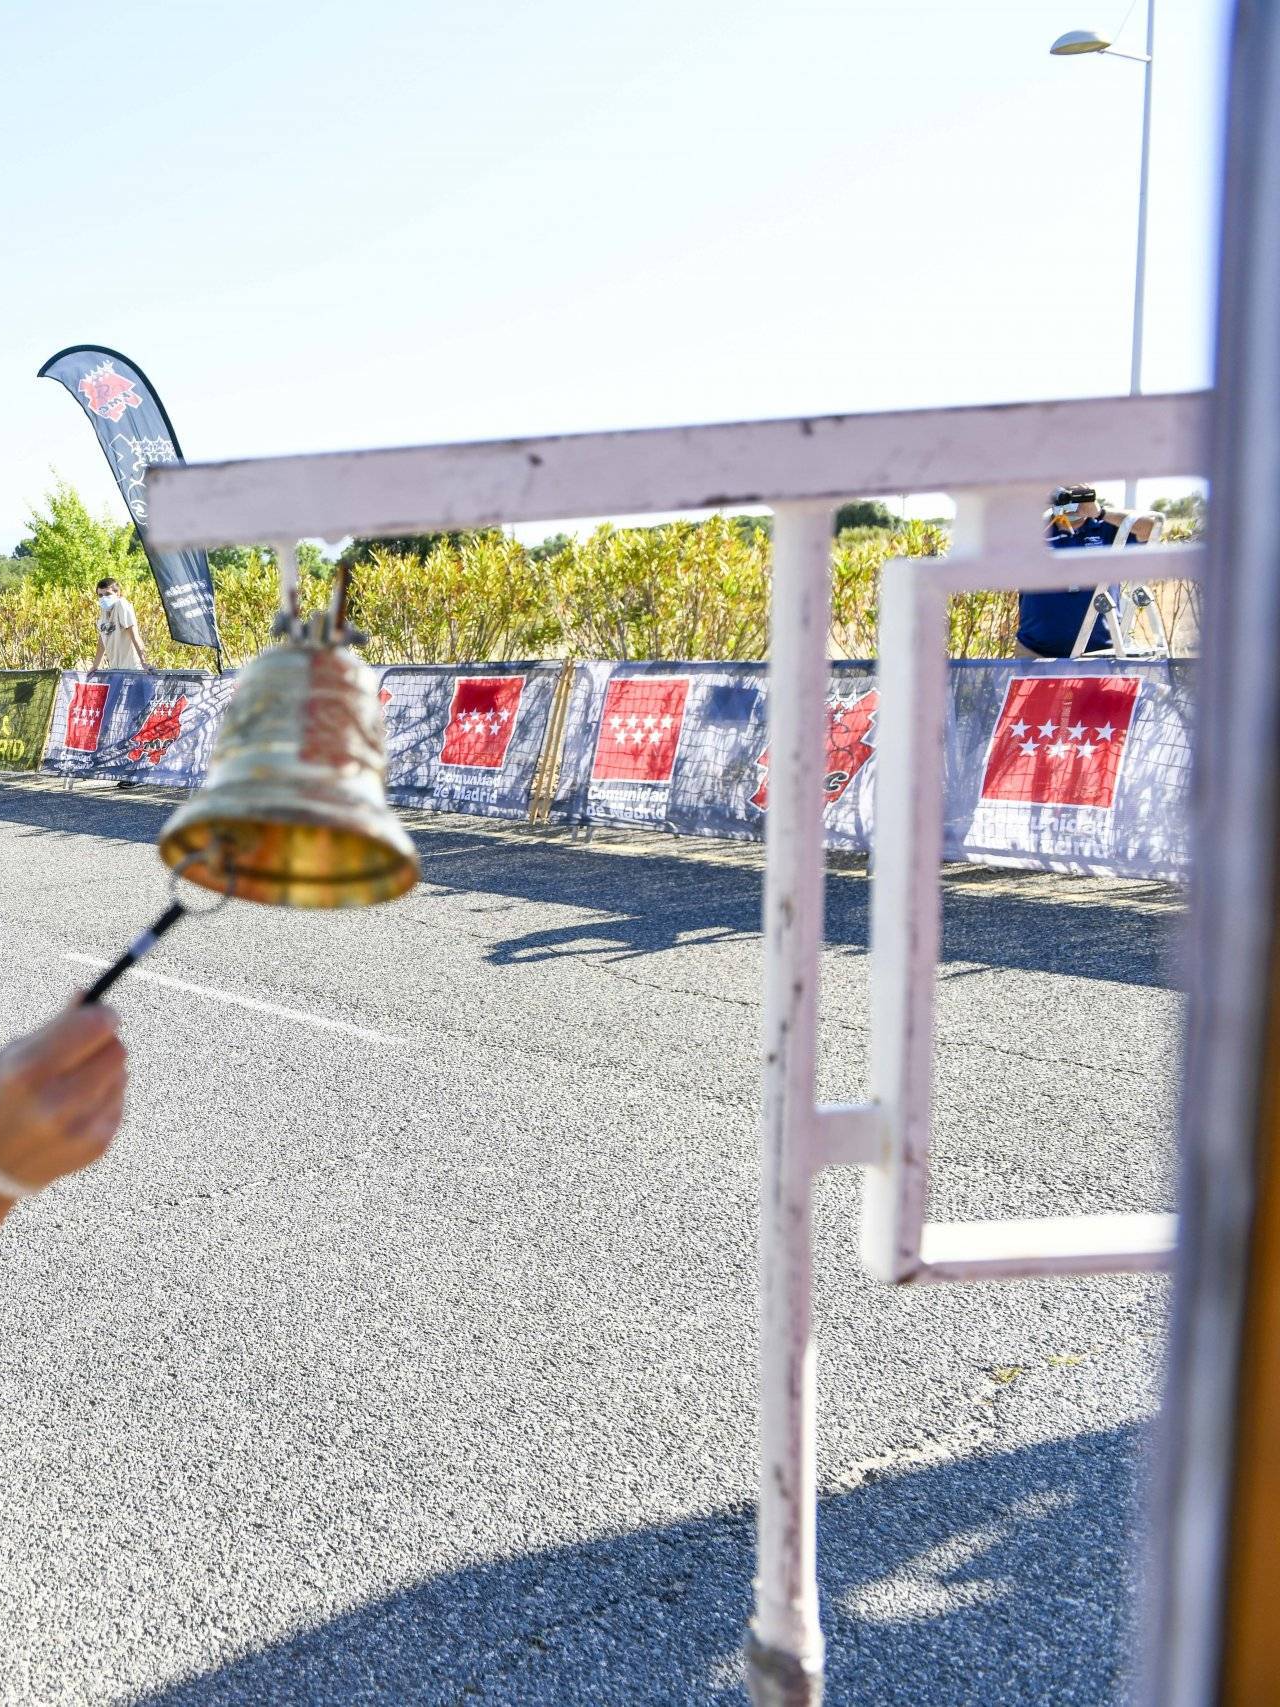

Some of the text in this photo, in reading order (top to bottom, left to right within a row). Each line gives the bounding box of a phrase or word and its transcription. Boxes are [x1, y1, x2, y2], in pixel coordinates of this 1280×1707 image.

[436, 769, 502, 787] Comunidad
[433, 782, 498, 803] de Madrid
[587, 785, 670, 803] Comunidad
[586, 801, 667, 820] de Madrid
